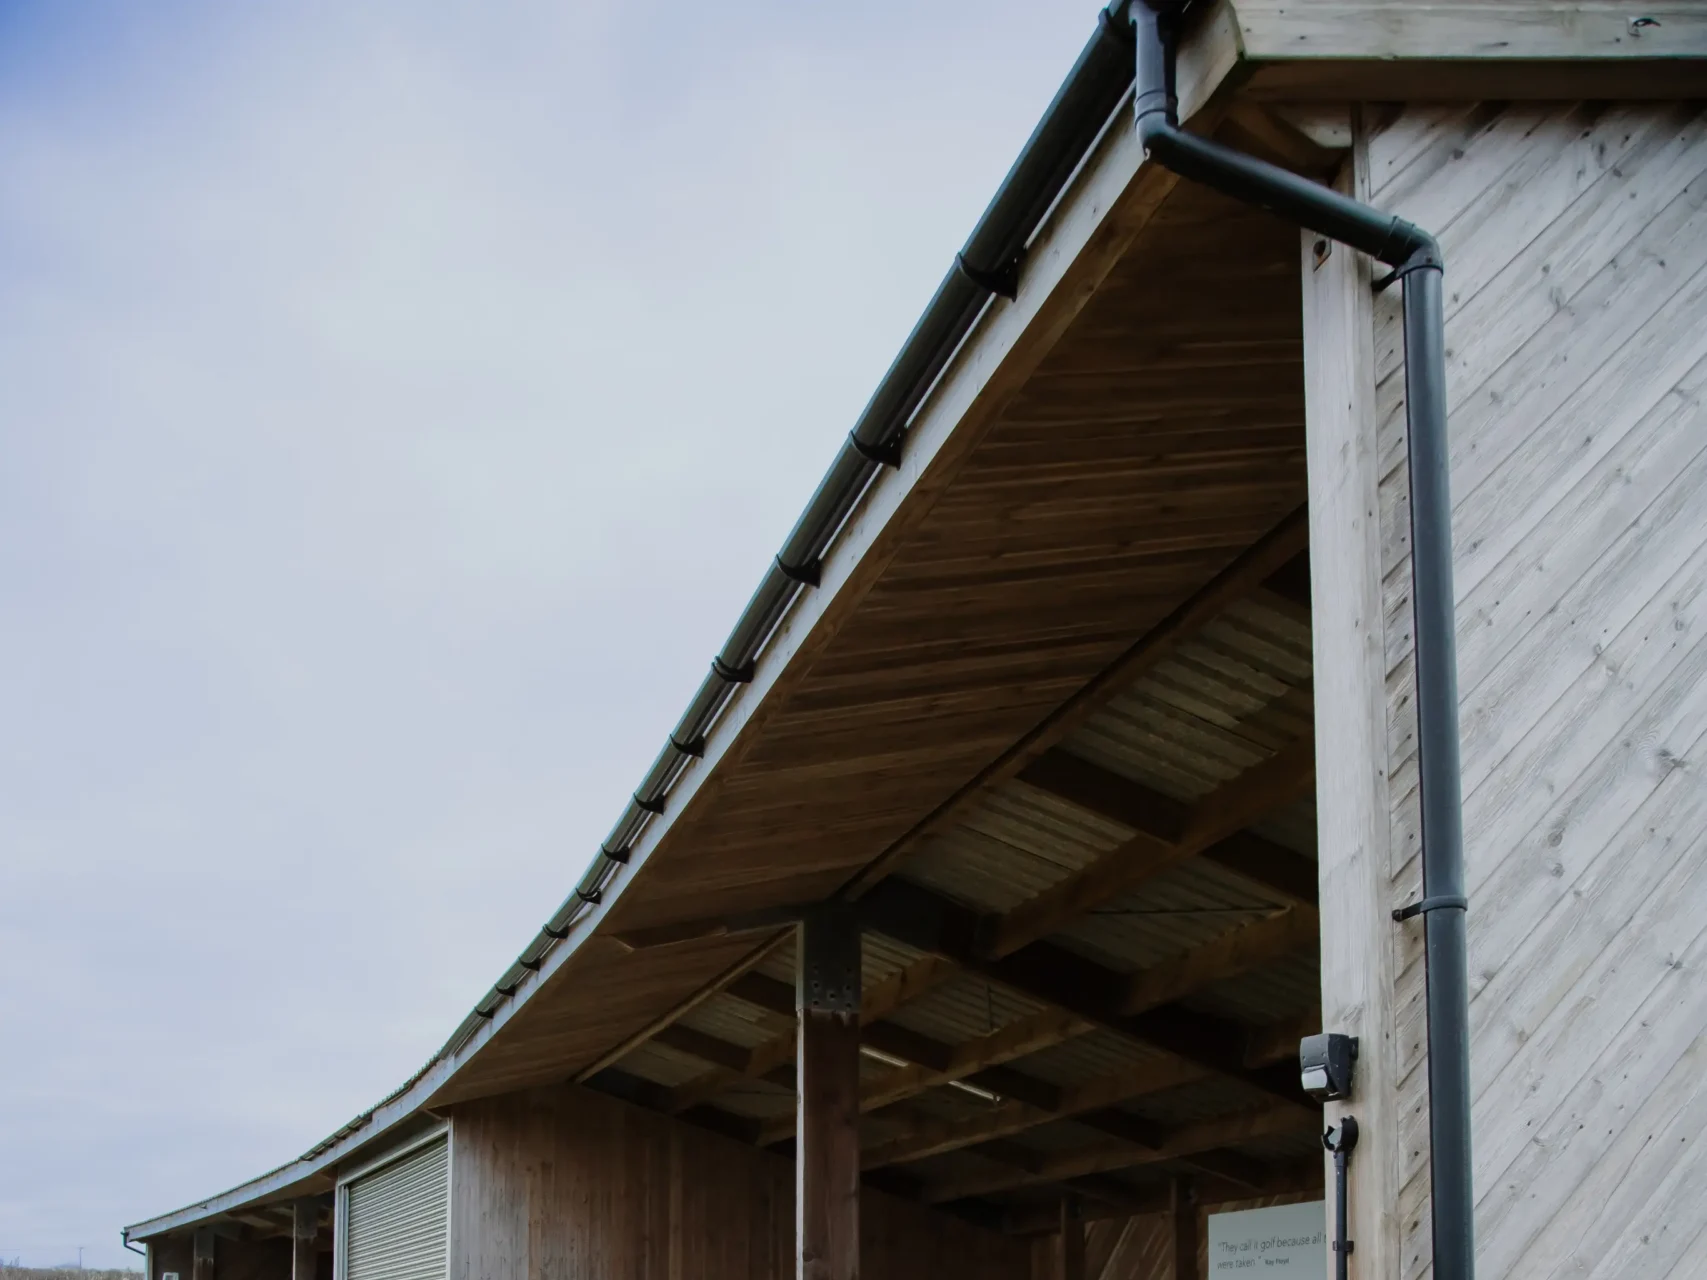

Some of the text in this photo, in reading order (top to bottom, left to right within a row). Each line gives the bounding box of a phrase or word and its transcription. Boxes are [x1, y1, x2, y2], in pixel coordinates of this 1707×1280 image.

[1240, 1239, 1252, 1252] call
[1254, 1240, 1259, 1250] it
[1260, 1236, 1276, 1252] golf
[1277, 1236, 1310, 1248] because
[1312, 1231, 1322, 1245] all
[1217, 1260, 1234, 1270] were
